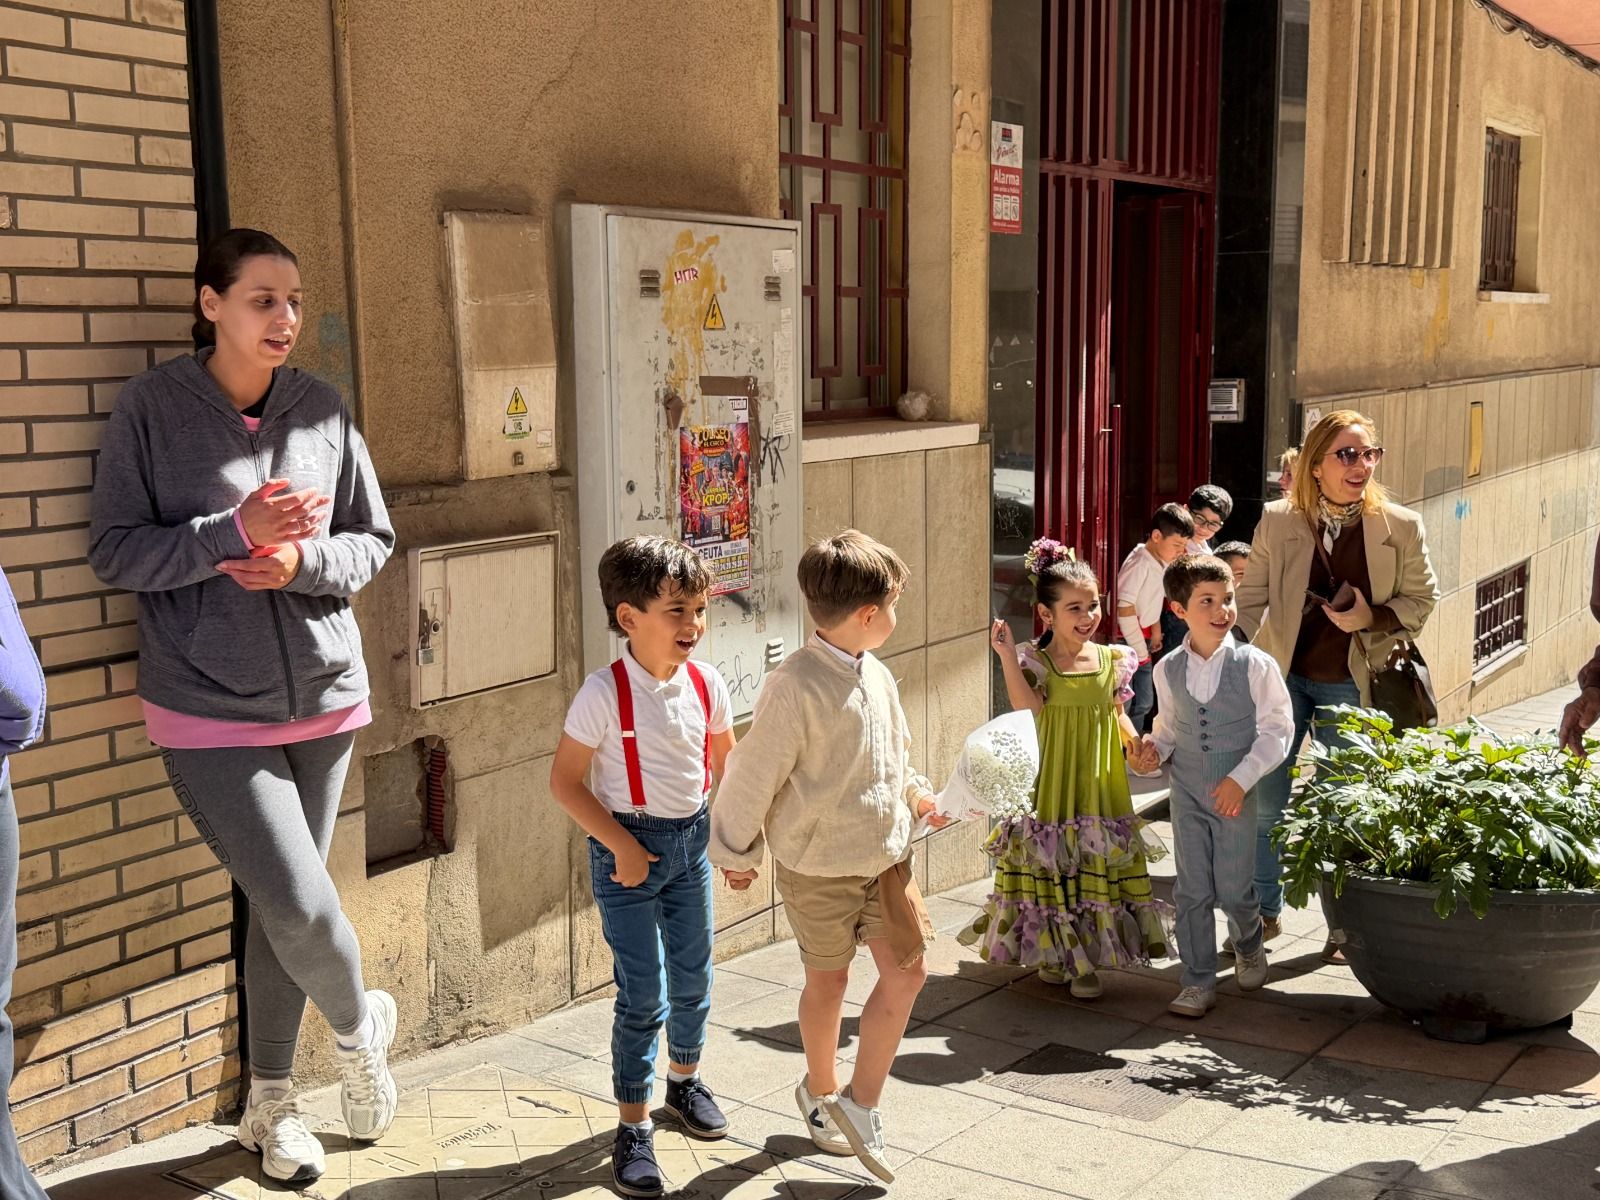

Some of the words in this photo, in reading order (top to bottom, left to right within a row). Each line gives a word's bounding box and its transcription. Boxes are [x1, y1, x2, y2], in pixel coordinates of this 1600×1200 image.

[993, 168, 1020, 186] Alarma
[702, 493, 728, 506] KPOP
[162, 749, 230, 864] NDER
